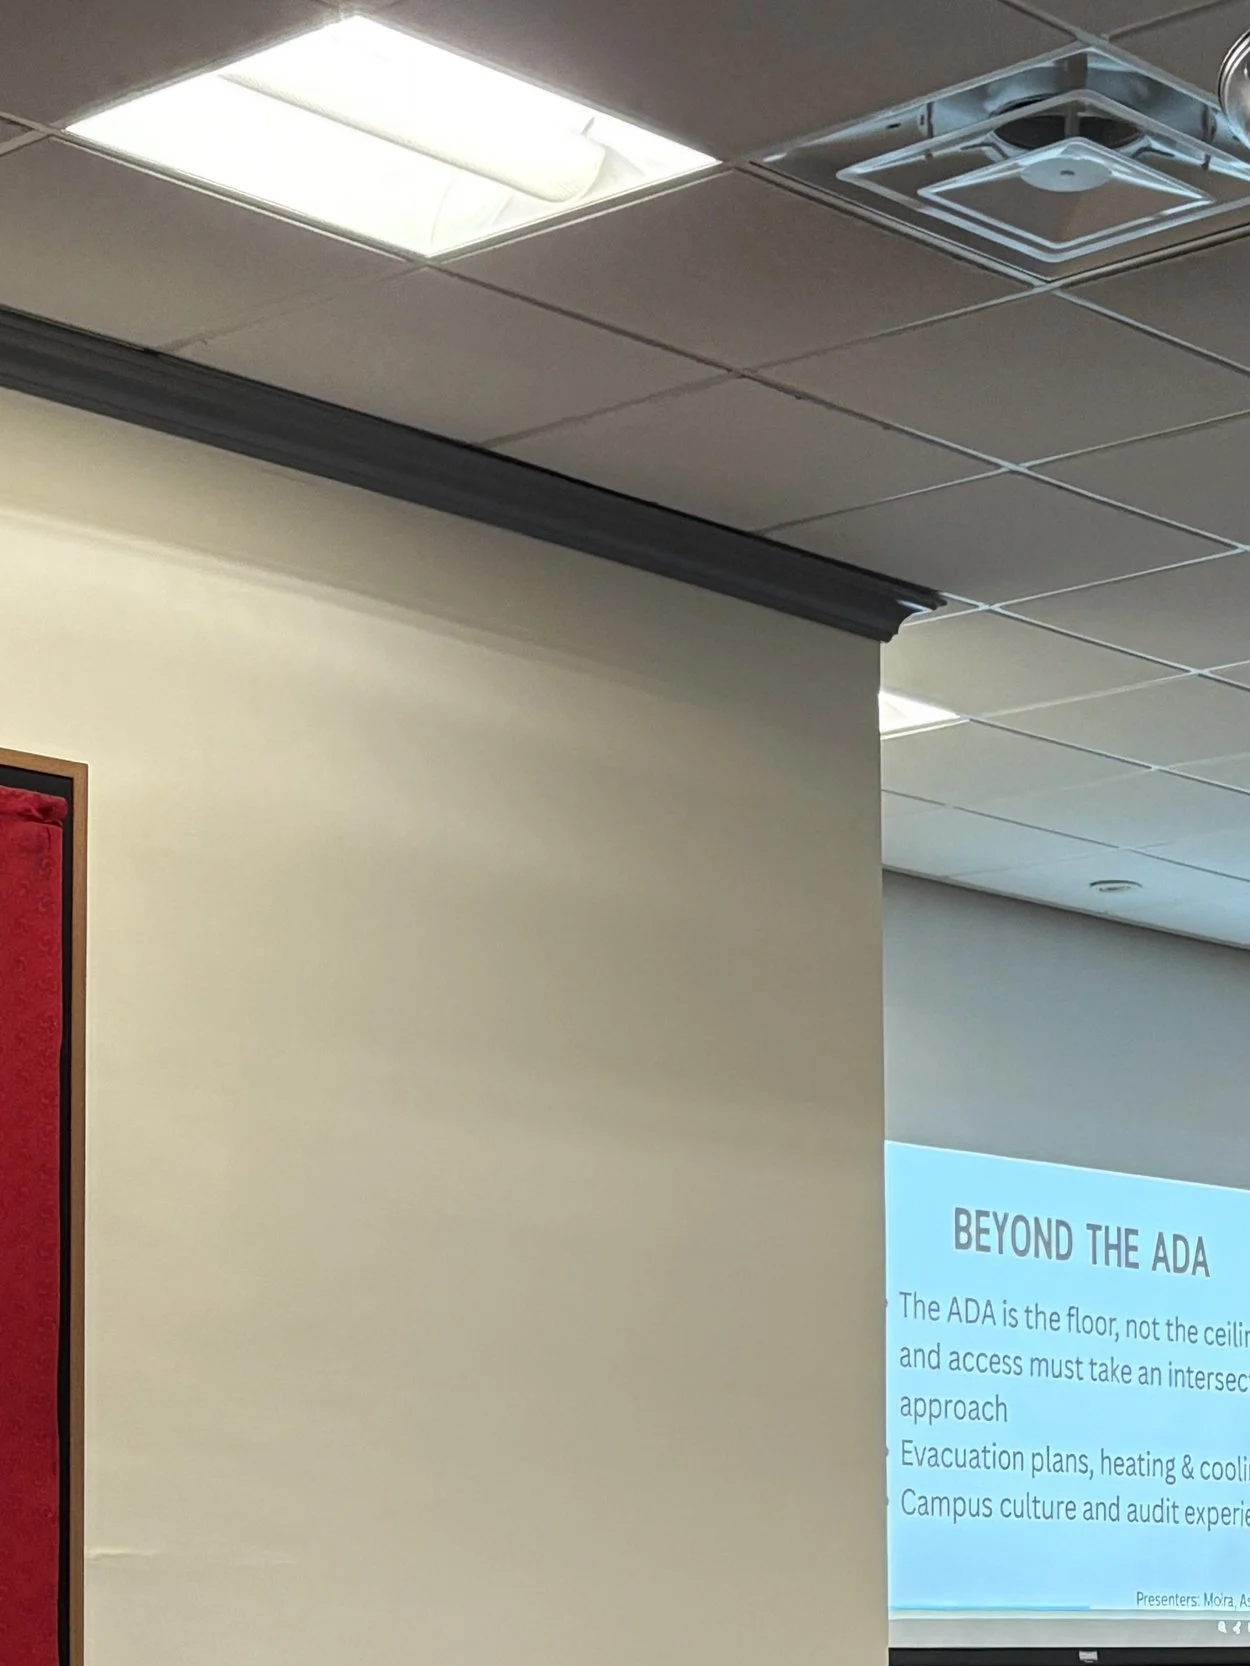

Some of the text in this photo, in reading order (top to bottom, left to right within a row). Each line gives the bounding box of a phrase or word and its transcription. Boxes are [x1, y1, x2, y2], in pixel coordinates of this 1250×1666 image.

[954, 1206, 1211, 1278] BEYOND THE ADA
[899, 1291, 941, 1322] The
[947, 1296, 997, 1326] ADA
[1002, 1299, 1019, 1329] is
[1024, 1302, 1061, 1332] the
[1066, 1306, 1120, 1343] floor,
[1126, 1317, 1161, 1341] not
[1165, 1316, 1199, 1345] the
[899, 1342, 941, 1371] and
[948, 1350, 1024, 1377] access
[1030, 1356, 1085, 1381] must
[1088, 1356, 1132, 1384] take
[1138, 1364, 1162, 1386] an
[899, 1394, 1008, 1426] approach
[901, 1439, 1025, 1472] Evacuation
[1031, 1445, 1095, 1481] plans,
[1100, 1447, 1177, 1486] heating
[1181, 1453, 1195, 1481] &
[900, 1488, 994, 1525] Campus
[1000, 1491, 1077, 1521] culture
[1082, 1495, 1121, 1523] and
[1126, 1497, 1180, 1525] audit
[1136, 1591, 1201, 1608] Presenters:
[1203, 1592, 1237, 1611] Moira,
